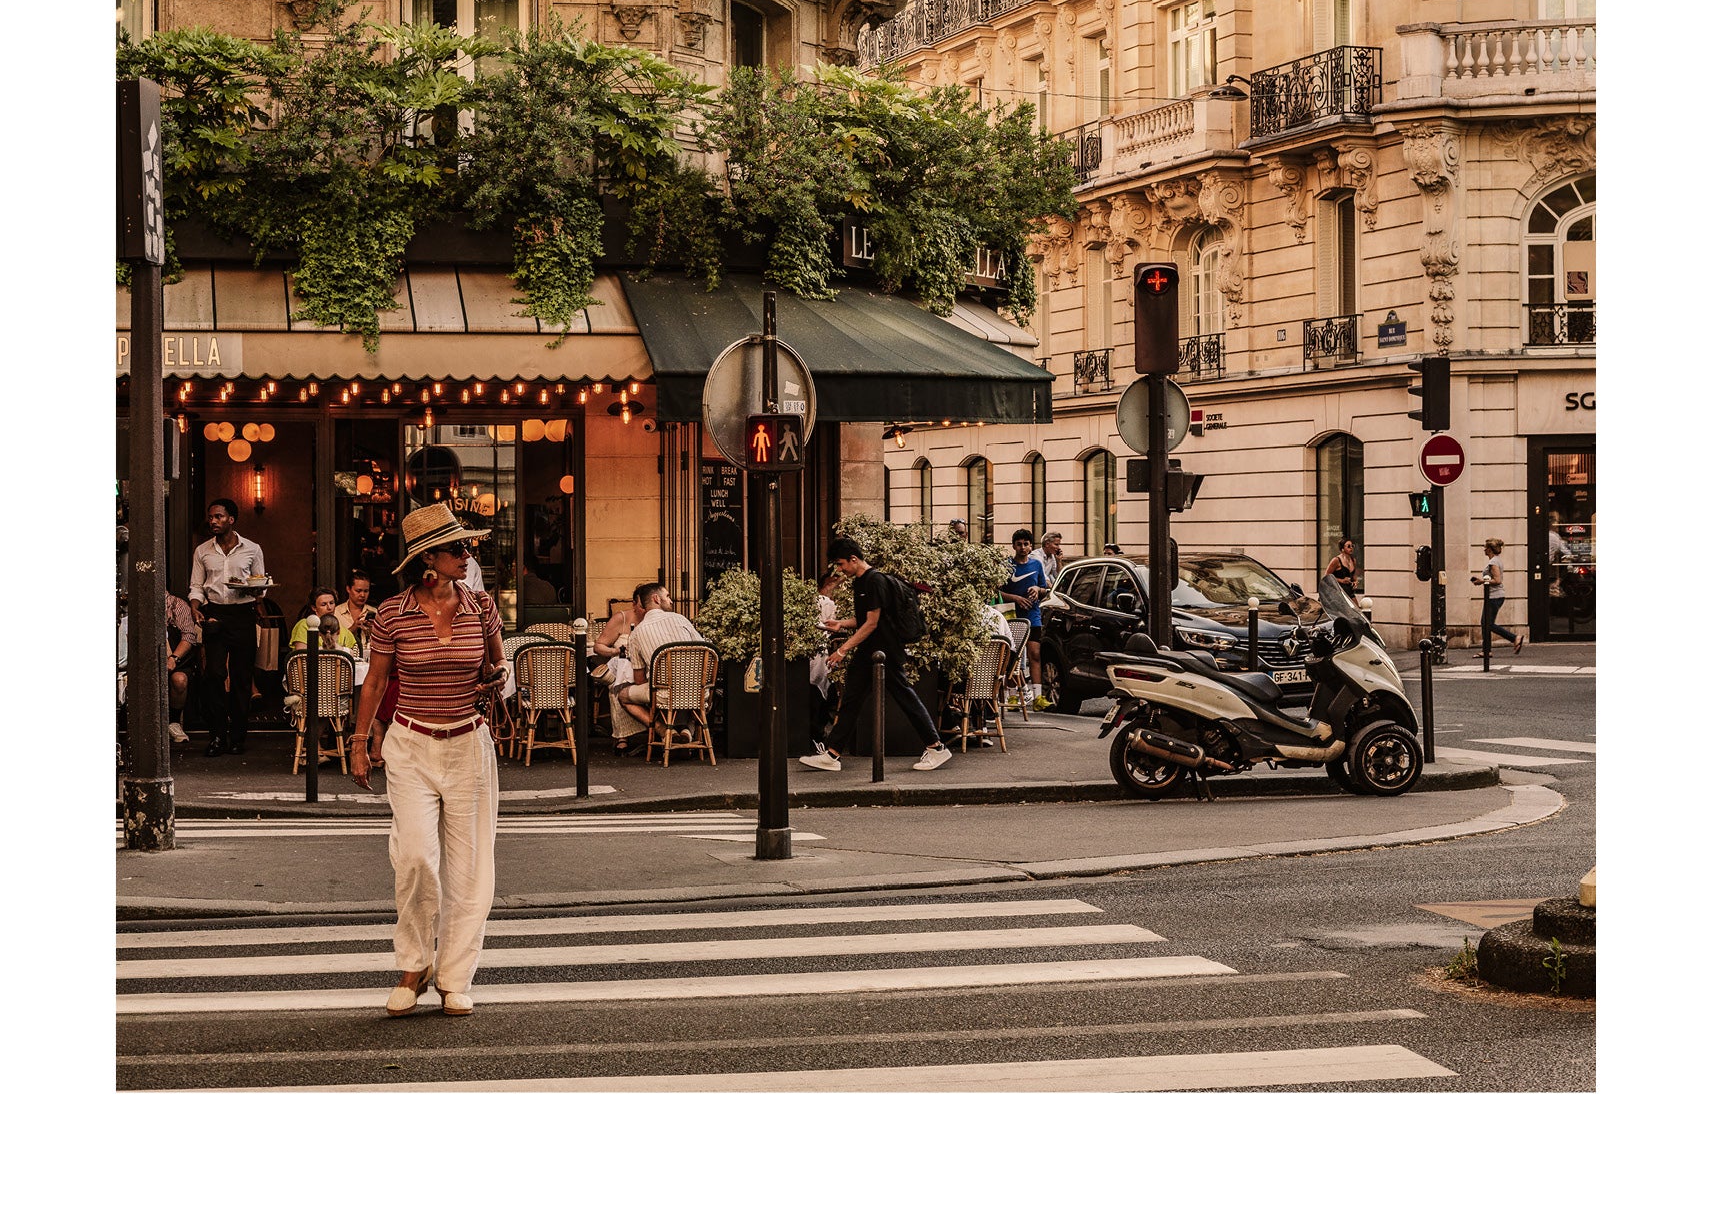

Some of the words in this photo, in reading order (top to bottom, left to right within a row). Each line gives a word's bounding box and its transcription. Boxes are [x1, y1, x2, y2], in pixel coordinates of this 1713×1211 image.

[851, 226, 875, 260] LE
[117, 337, 221, 366] PELLA
[1565, 392, 1596, 411] SG
[723, 477, 736, 487] FAST
[710, 489, 729, 498] LUNCH
[711, 499, 726, 508] WELL
